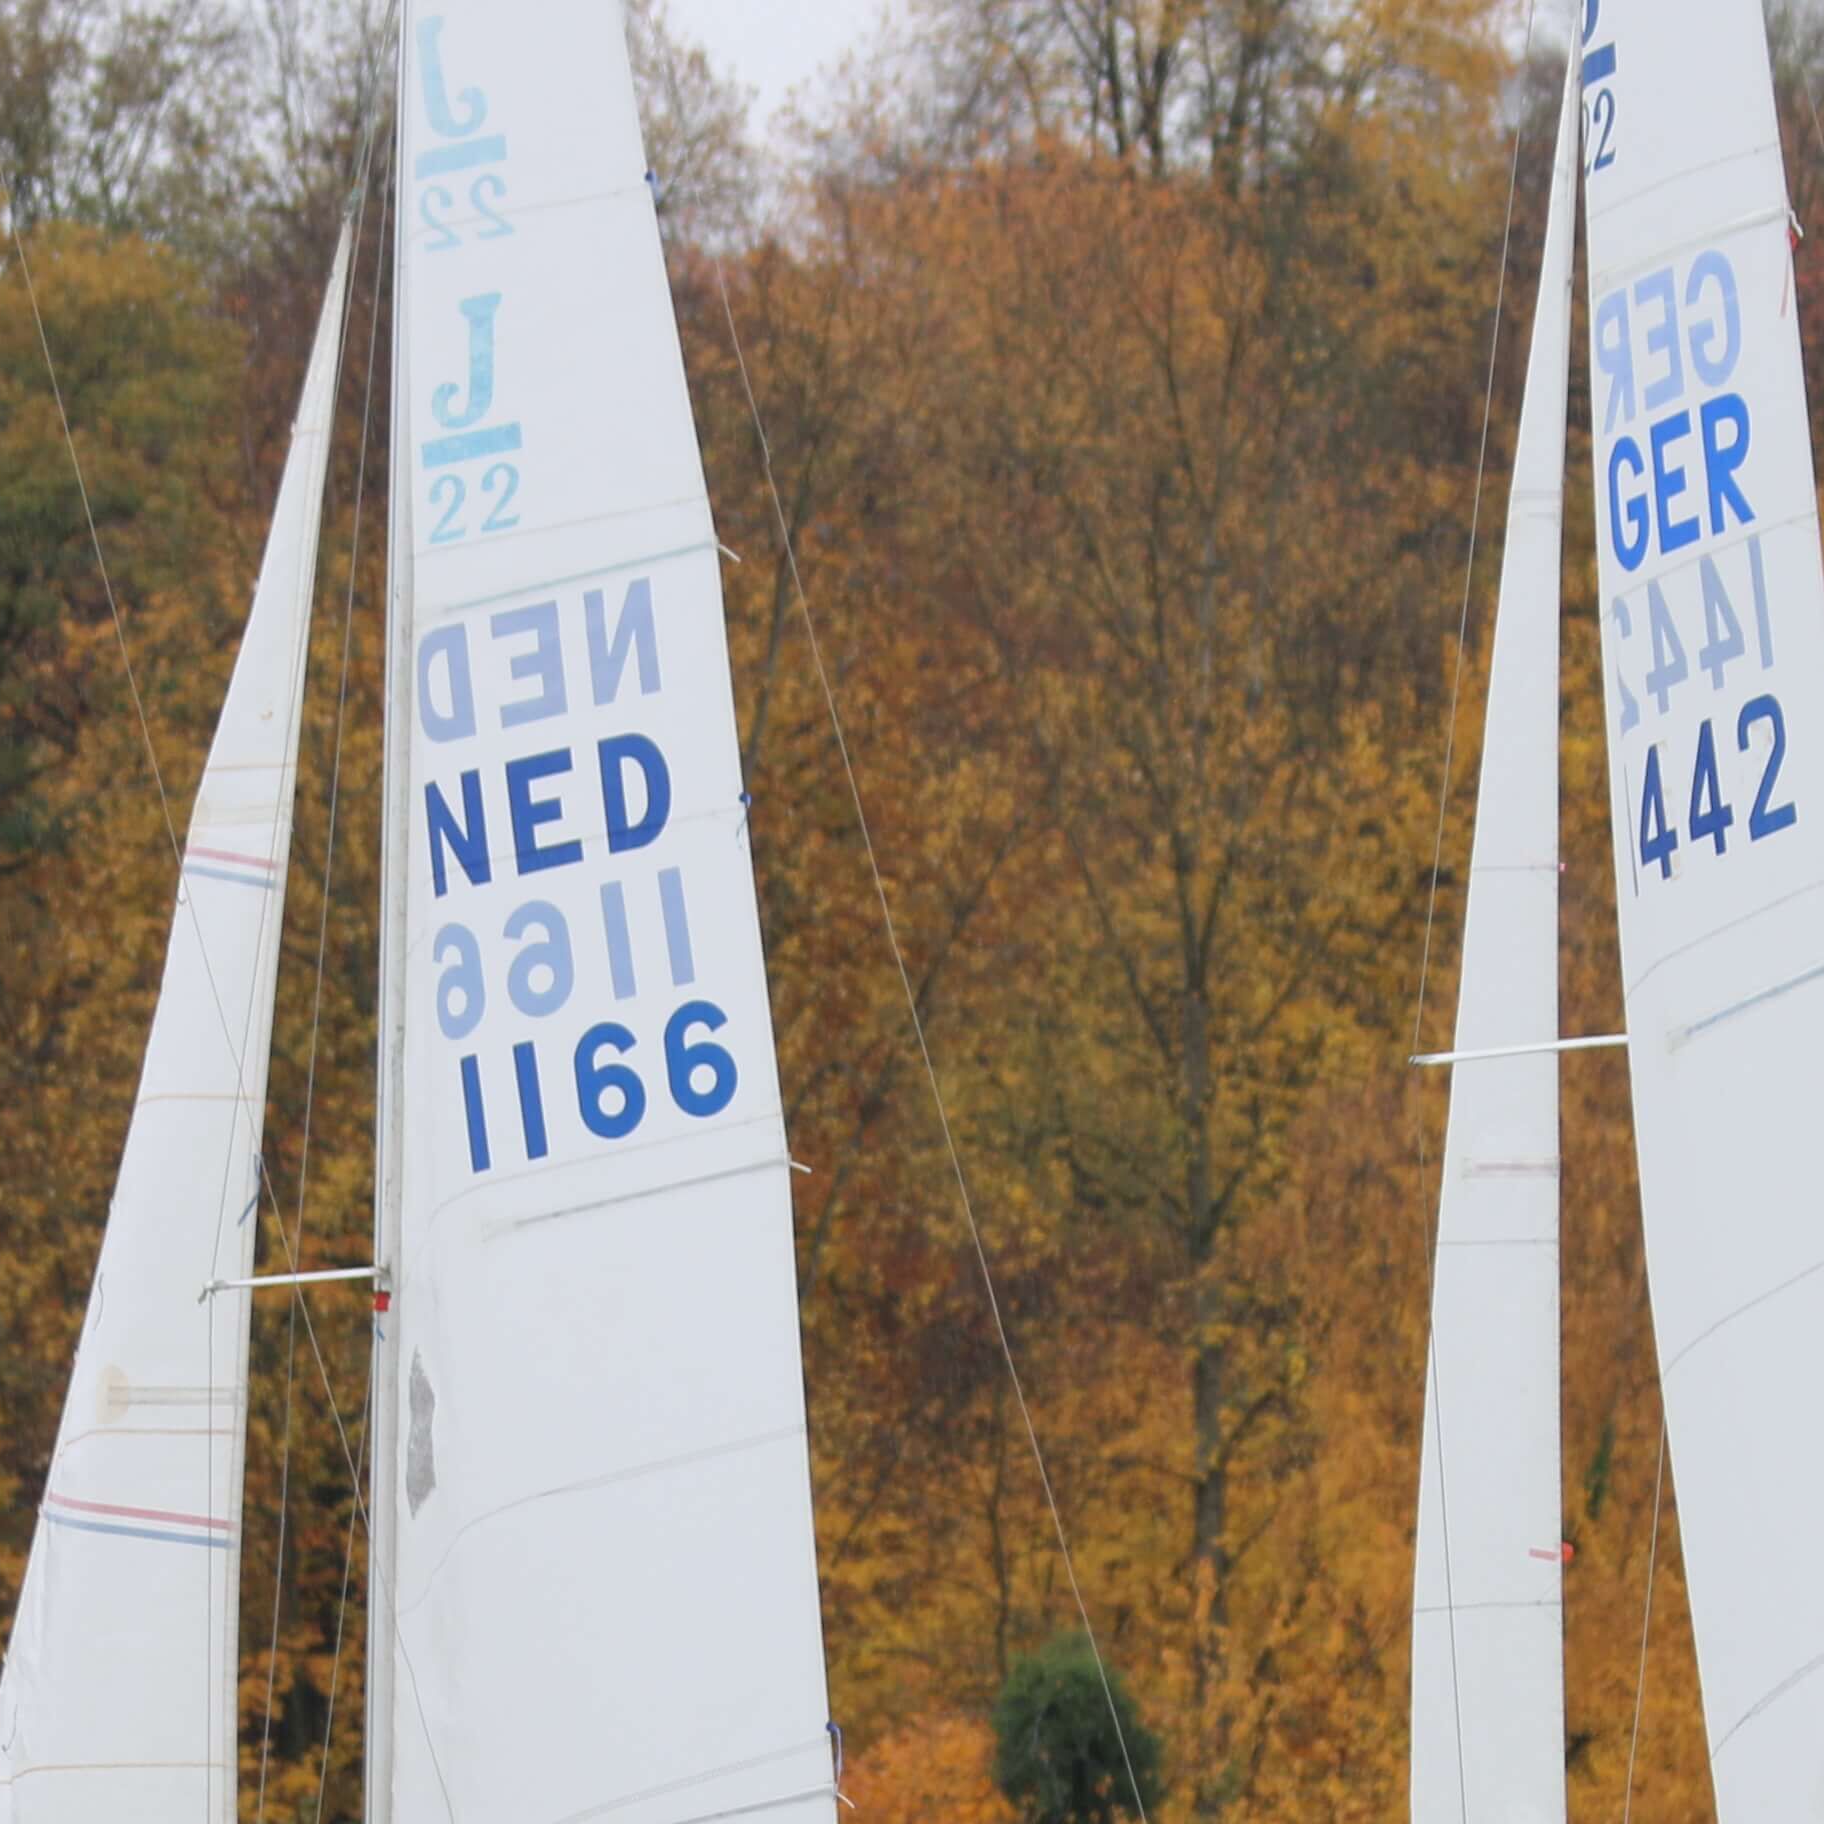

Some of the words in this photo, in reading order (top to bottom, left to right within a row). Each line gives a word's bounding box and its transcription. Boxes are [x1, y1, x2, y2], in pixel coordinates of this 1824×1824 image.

[431, 291, 503, 429] J
[428, 463, 521, 545] 22
[1608, 392, 1756, 573] GER
[424, 731, 672, 899] NED
[1624, 693, 1797, 897] 442
[460, 1000, 738, 1174] 1166
